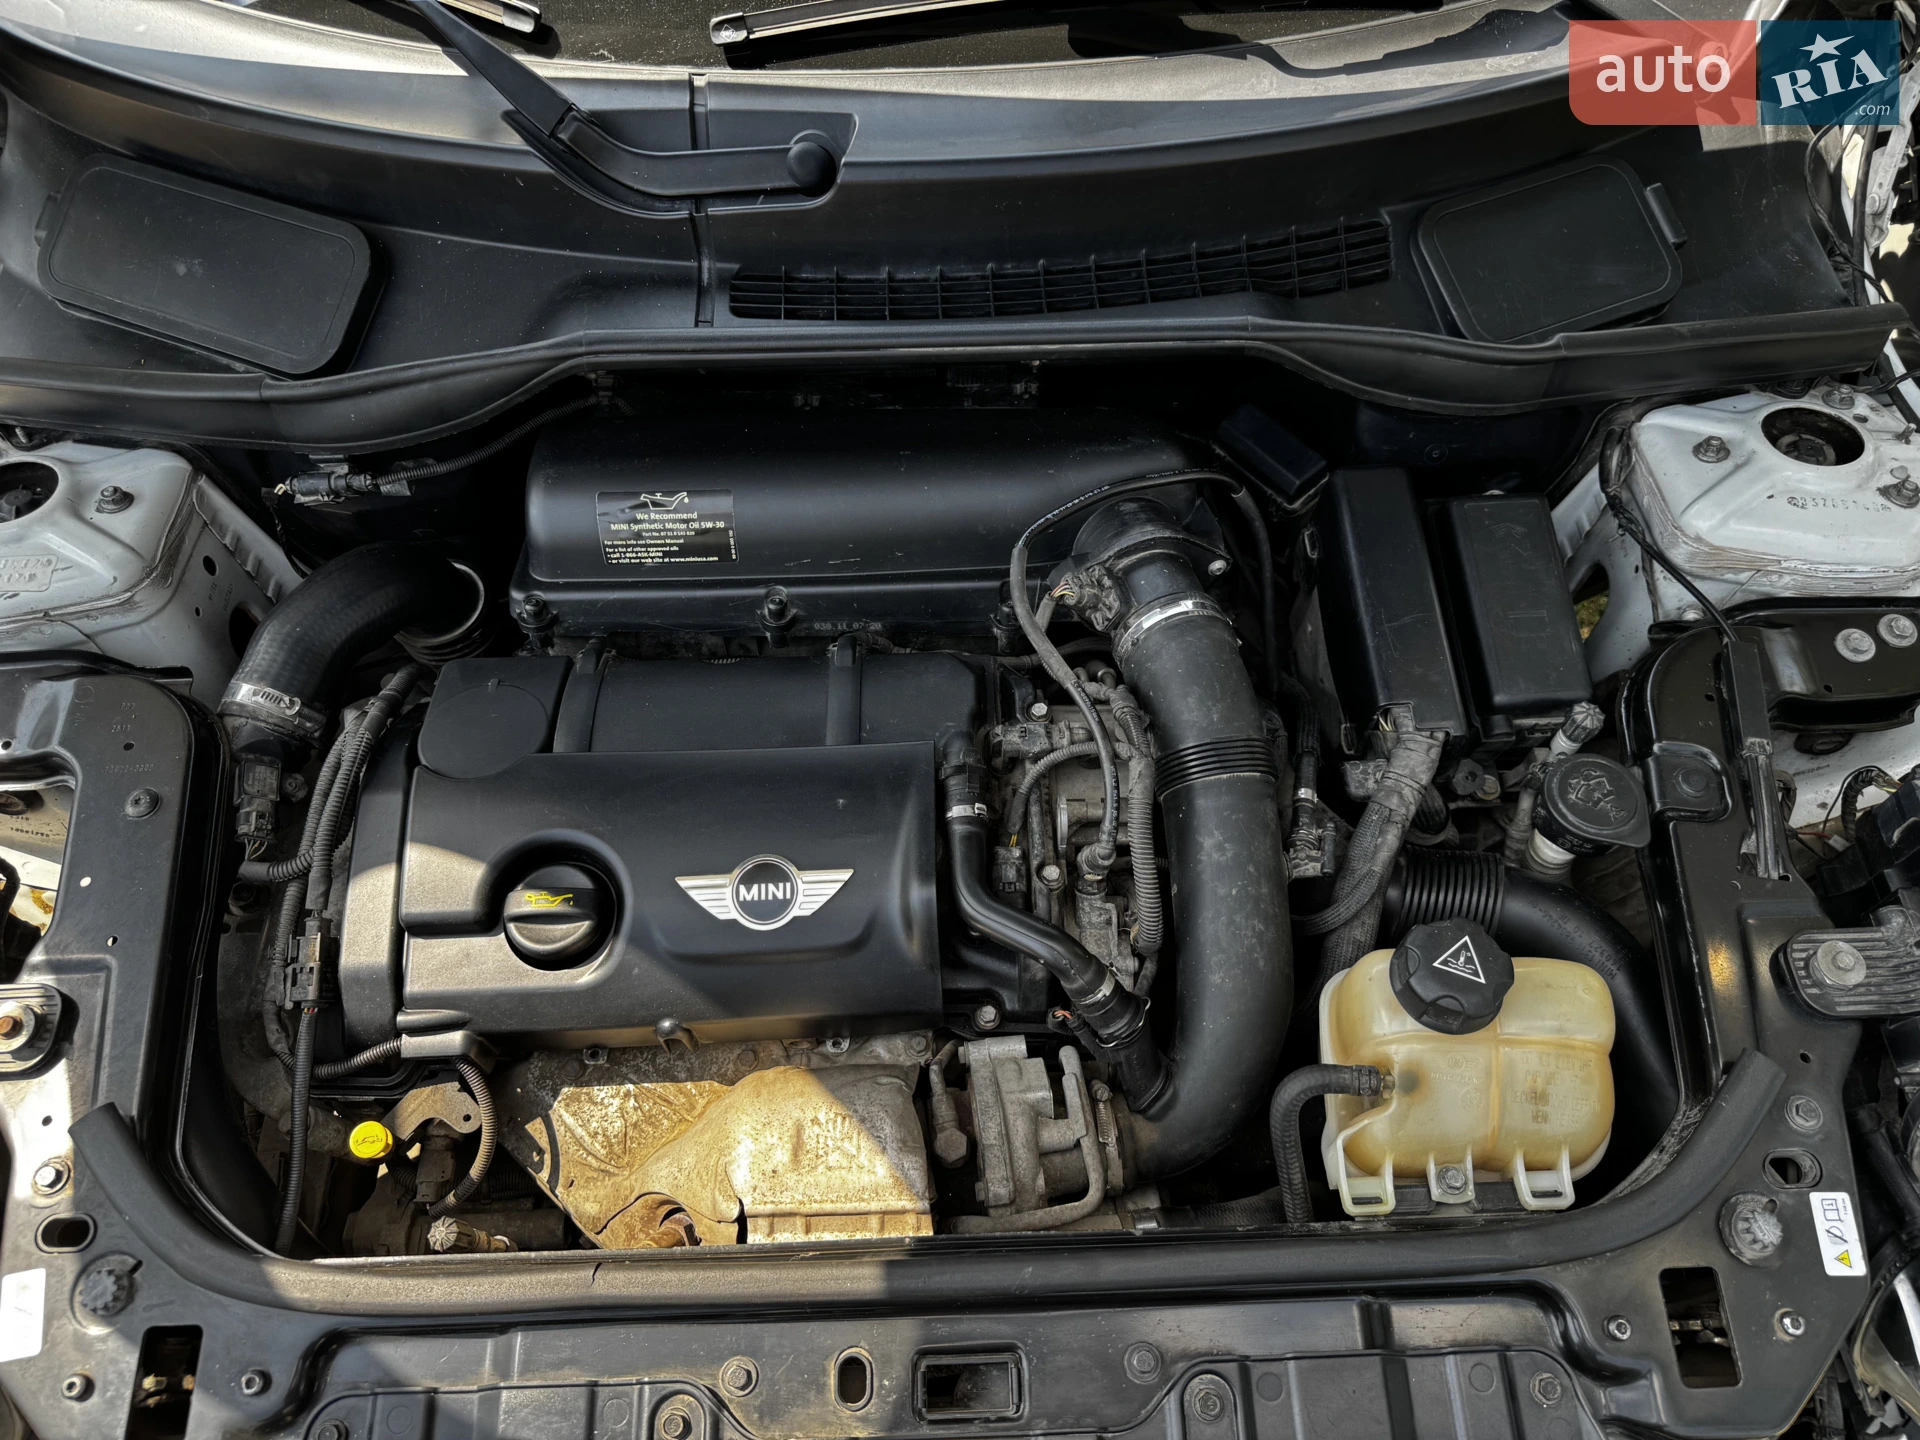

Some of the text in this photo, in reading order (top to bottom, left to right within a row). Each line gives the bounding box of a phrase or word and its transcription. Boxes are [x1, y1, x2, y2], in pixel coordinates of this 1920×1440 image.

[636, 511, 698, 520] We Recommend
[610, 523, 629, 531] MINI
[630, 522, 664, 532] Synthetic
[688, 521, 700, 529] Oil
[701, 521, 725, 529] 5W-30
[739, 882, 791, 902] MINI
